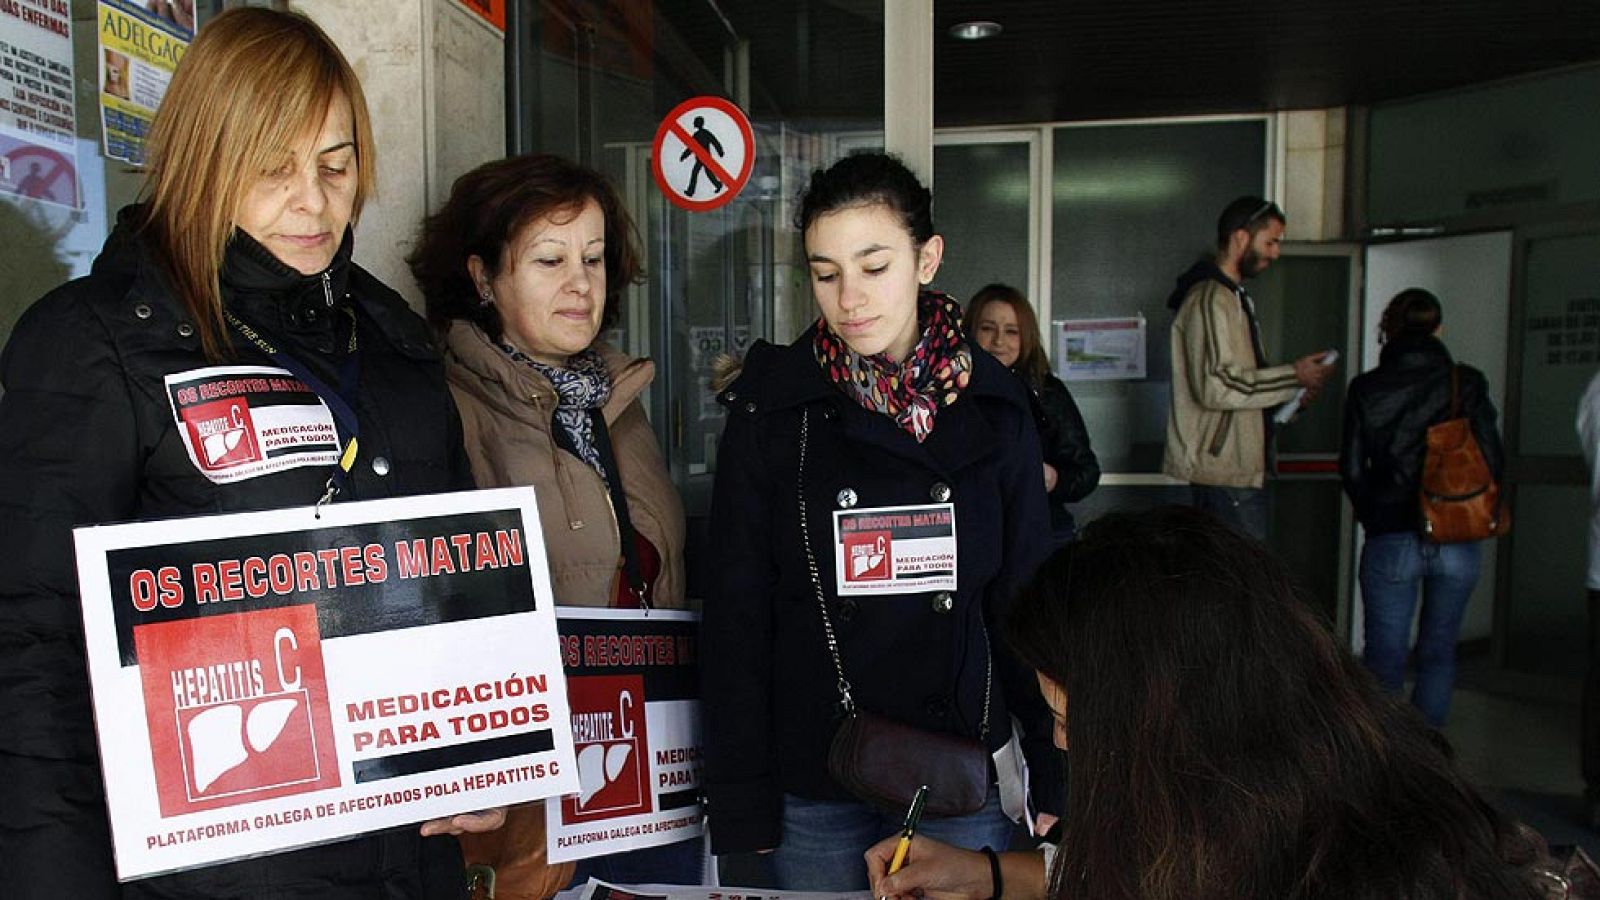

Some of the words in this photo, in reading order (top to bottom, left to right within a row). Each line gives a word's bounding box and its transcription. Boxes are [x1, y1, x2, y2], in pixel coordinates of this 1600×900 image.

[23, 5, 69, 38] ENFERMAS
[231, 405, 245, 428] C
[262, 424, 333, 437] MEDICACIÓN
[265, 437, 298, 448] PARA
[300, 433, 336, 443] TODOS
[877, 535, 886, 555] C
[896, 553, 954, 563] MEDICACIÓN
[130, 567, 184, 612] OS
[192, 543, 387, 604] RECORTES
[395, 528, 524, 579] MATAN
[924, 562, 953, 570] TODOS
[584, 634, 675, 667] RECORTES
[171, 659, 265, 708] HEPATITIS
[273, 626, 301, 692] C
[346, 672, 548, 722] MEDICACIÓN
[352, 721, 441, 752] PARA
[449, 703, 550, 735] TODOS
[572, 712, 614, 741] HEPATITE
[620, 690, 634, 738] C
[659, 769, 692, 787] PARA
[146, 818, 250, 850] PLATAFORMA
[254, 807, 313, 829] GALEGA
[316, 803, 336, 818] DE
[339, 788, 422, 815] AFECTADOS
[424, 781, 461, 800] POLA
[463, 764, 546, 791] HEPATITIS
[549, 760, 560, 776] C
[557, 830, 609, 848] PLATAFORMA
[611, 824, 641, 839] GALEGA
[642, 822, 653, 834] DE
